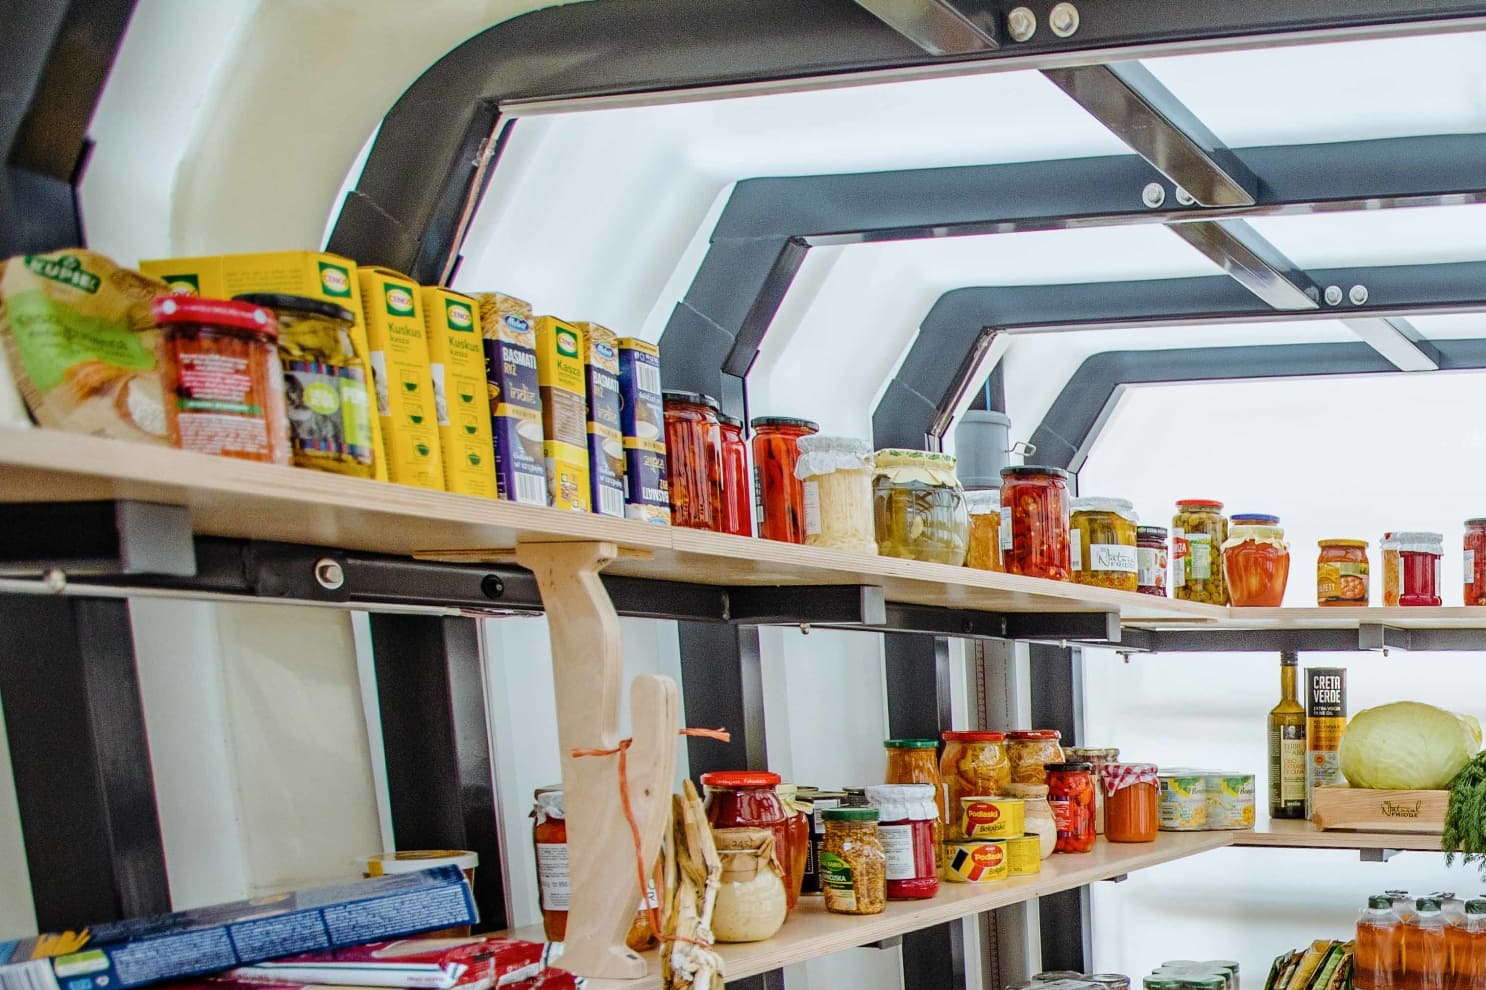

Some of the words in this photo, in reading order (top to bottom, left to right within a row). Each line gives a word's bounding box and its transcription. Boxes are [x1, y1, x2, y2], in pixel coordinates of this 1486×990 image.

[502, 347, 537, 370] BASMATI
[591, 370, 620, 394] BASMATI
[1313, 676, 1341, 690] CRETA
[1313, 690, 1341, 703] VERDE
[967, 810, 998, 819] Podlaski
[974, 852, 1003, 861] Podlaski
